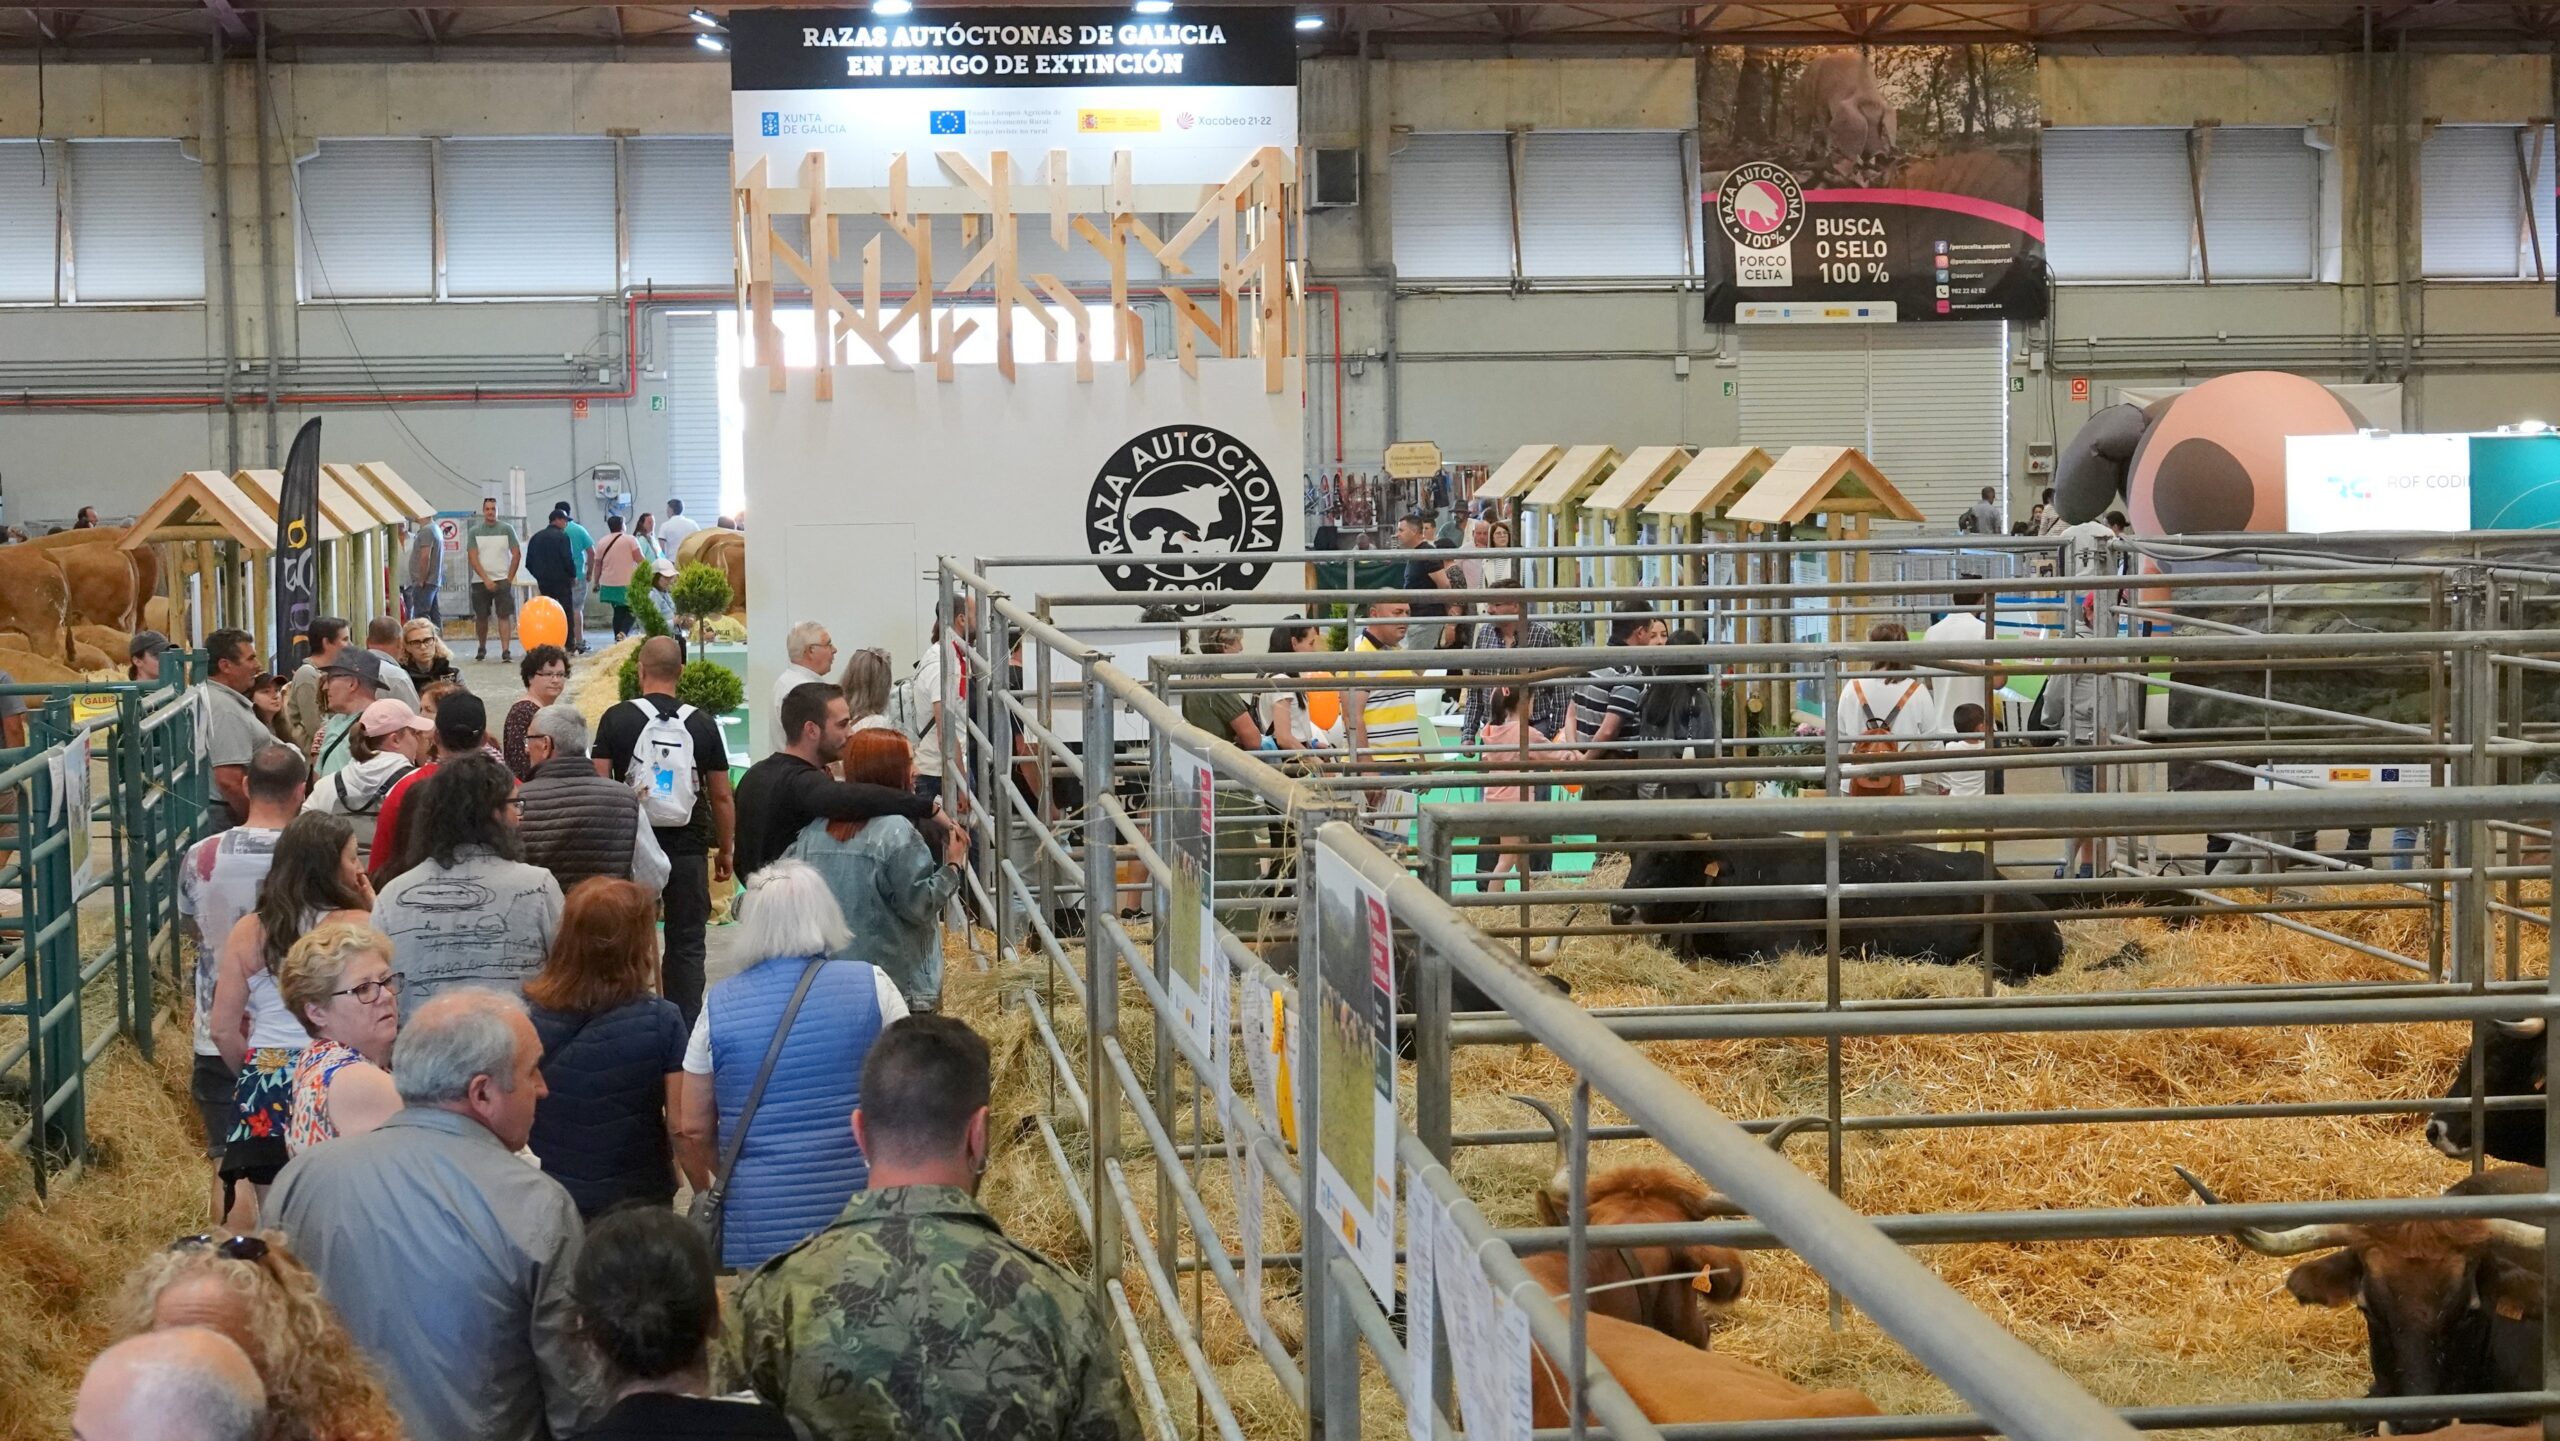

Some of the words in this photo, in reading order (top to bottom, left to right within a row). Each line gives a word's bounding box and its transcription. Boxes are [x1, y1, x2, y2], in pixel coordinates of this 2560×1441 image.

[803, 26, 887, 47] RAZAS
[891, 22, 1073, 47] AUTÓCTONAS
[1079, 25, 1114, 45] DE
[1118, 24, 1226, 45] GALICIA
[847, 55, 884, 76] EN
[890, 55, 989, 76] PERIGO
[994, 55, 1029, 75] DE
[1035, 49, 1184, 75] EXTINCIÓN
[783, 113, 822, 123] XUNTA
[1198, 116, 1246, 126] Xacobeo
[783, 124, 798, 134] DE
[801, 124, 847, 134] GALICIA
[1723, 186, 1738, 225] RAZA
[1736, 167, 1801, 220] AUTÓCTONA
[1815, 218, 1886, 236] BUSCA
[1744, 231, 1786, 248] 100%
[1816, 241, 1830, 258] O
[1835, 240, 1888, 259] SELO
[1740, 256, 1787, 267] PORCO
[1744, 269, 1783, 280] CELTA
[1819, 262, 1861, 284] 100
[1867, 262, 1890, 283] %
[2387, 474, 2420, 488] ROF
[1094, 475, 1133, 554] RAZA
[1131, 431, 1277, 549] AUTÓCTONA
[84, 695, 115, 705] GALBIS
